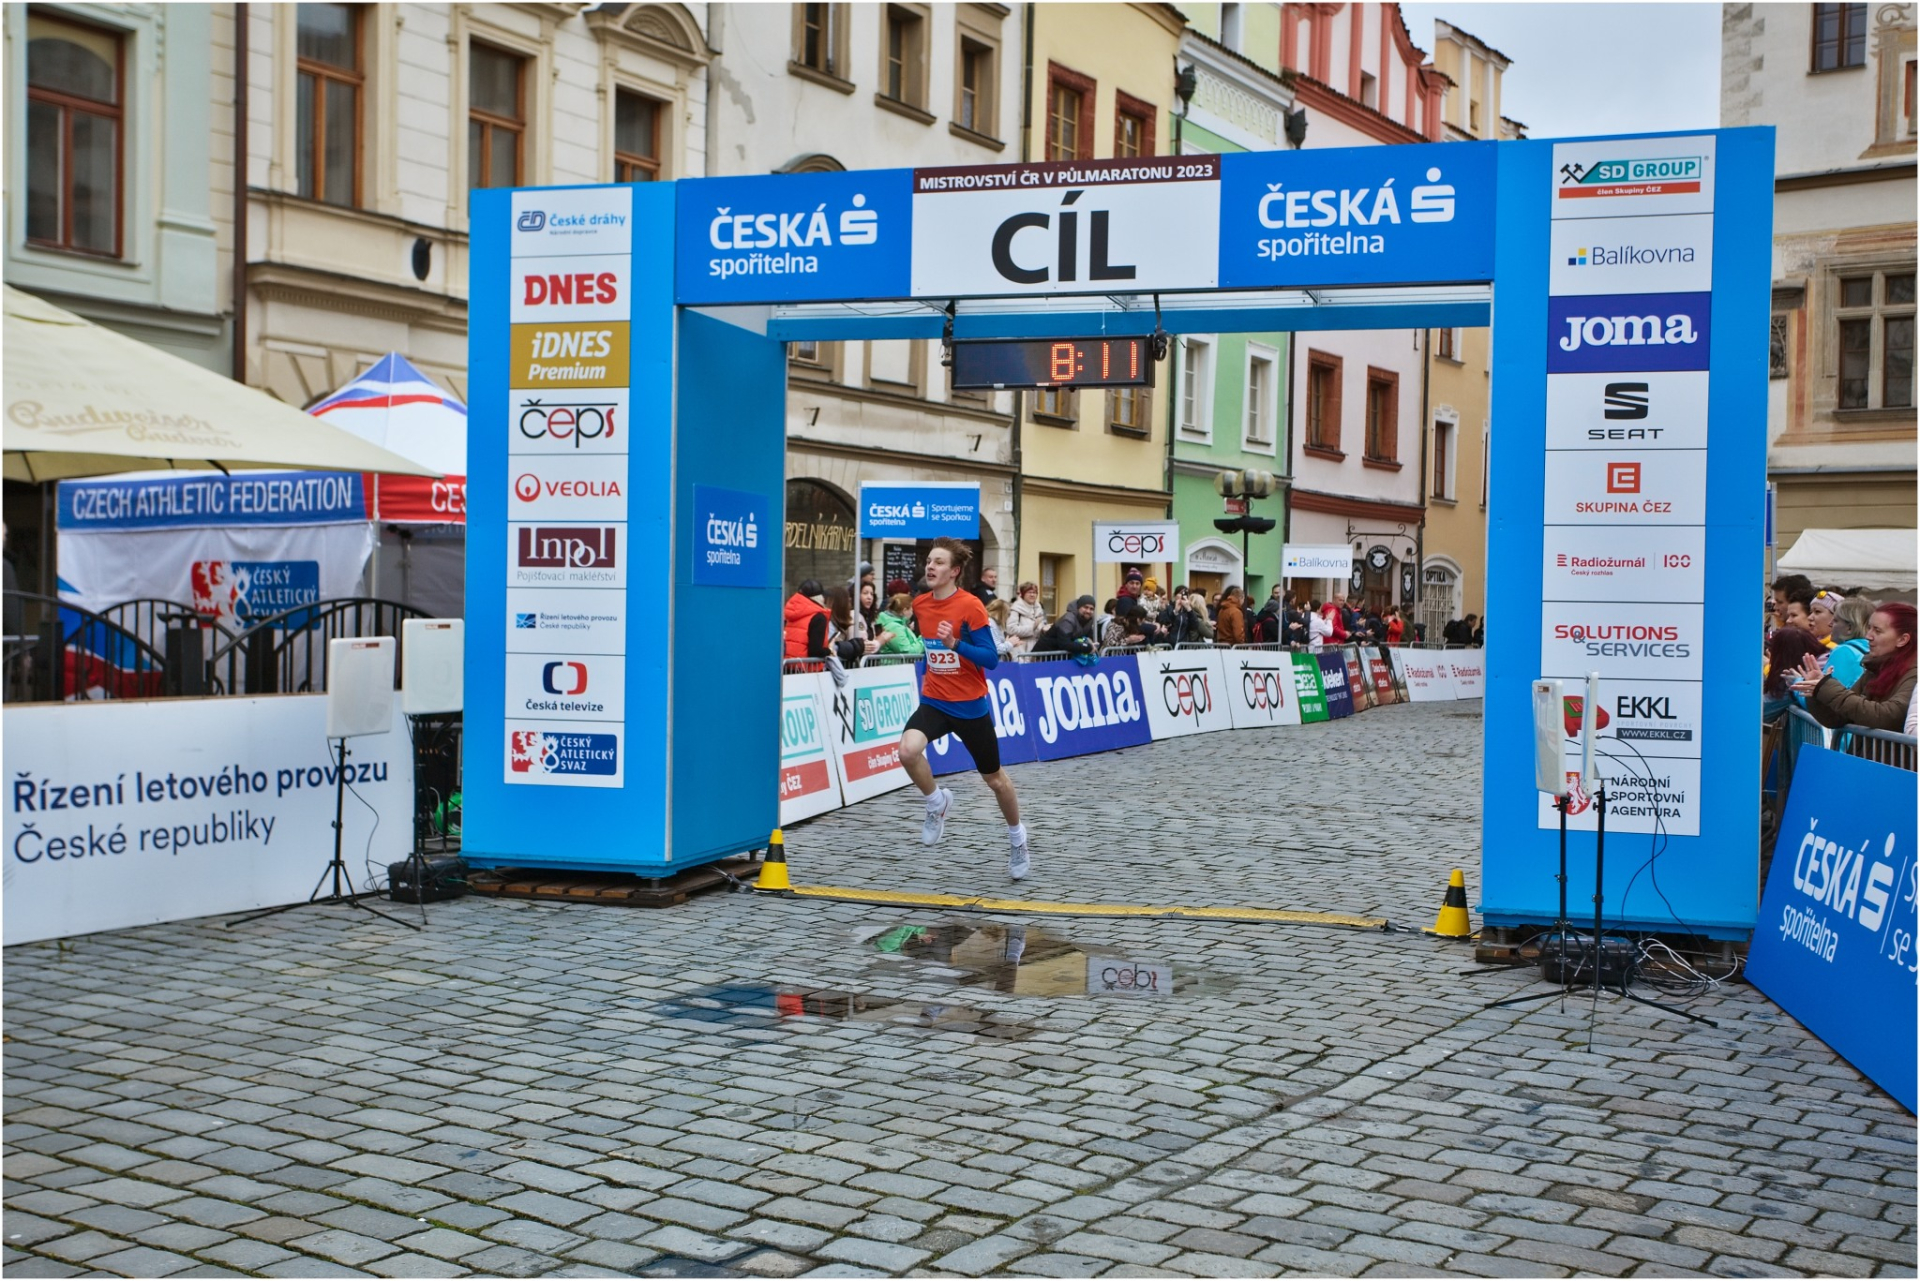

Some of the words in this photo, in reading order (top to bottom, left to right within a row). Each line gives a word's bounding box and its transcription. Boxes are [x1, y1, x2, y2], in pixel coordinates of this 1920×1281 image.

[920, 169, 1017, 191] MISTROVSTVÍ
[1020, 169, 1040, 186] ČR
[1043, 171, 1054, 185] V
[1058, 166, 1173, 184] PŮLMARATONU
[1176, 164, 1213, 179] 2023
[1598, 163, 1626, 179] SD
[1632, 160, 1697, 178] GROUP
[1597, 187, 1614, 196] člen
[1615, 186, 1645, 195] Skupiny
[1646, 185, 1662, 193] ČEZ
[1257, 178, 1402, 230] ČESKÁ
[549, 213, 585, 227] České
[589, 213, 627, 227] dráhy
[708, 203, 833, 250] ČESKÁ
[990, 189, 1138, 285] CÍL
[1256, 231, 1385, 262] spořitelna
[1591, 244, 1696, 266] Balíkovna
[708, 252, 819, 280] spořitelna
[523, 272, 618, 306] DNES
[531, 330, 613, 359] iDNES
[1051, 341, 1138, 382] 8:11
[528, 363, 607, 382] Premium
[1587, 428, 1665, 441] SEAT
[72, 488, 133, 520] CZECH
[135, 484, 226, 516] ATHLETIC
[229, 476, 353, 514] FEDERATION
[545, 480, 622, 498] VEOLIA
[869, 502, 911, 518] ČESKÁ
[931, 503, 974, 514] Sportujeme
[1575, 501, 1639, 514] SKUPINA
[1643, 499, 1672, 514] ČEZ
[706, 512, 746, 548] ČESKÁ
[868, 517, 906, 527] spořitelna
[706, 547, 741, 565] spořitelna
[1299, 556, 1349, 568] Balíkovna
[1571, 556, 1646, 569] Radiožurnál
[252, 565, 291, 586] ČESKÝ
[1571, 568, 1590, 577] Český
[251, 584, 318, 605] ATLETICKÝ
[540, 612, 561, 621] Řízení
[561, 613, 590, 621] letového
[591, 615, 618, 623] provozu
[1554, 624, 1679, 641] SOLUTIONS
[929, 652, 956, 664] 923
[1585, 642, 1691, 658] SERVICES
[525, 698, 558, 711] Česká
[560, 700, 604, 713] televize
[858, 697, 875, 733] SD
[876, 691, 913, 729] GROUP
[1617, 696, 1678, 720] EKKL
[560, 735, 593, 749] ČESKÝ
[1621, 729, 1687, 740] WWW.EKKL.CZ
[560, 748, 615, 761] ATLETICKÝ
[560, 760, 587, 772] SVAZ
[13, 771, 125, 813] Řízení
[136, 764, 269, 804] letového
[276, 761, 388, 798] provozu
[1610, 773, 1671, 789] NÁRODNÍ
[1609, 790, 1685, 804] SPORTOVNÍ
[1609, 805, 1682, 818] AGENTURA
[13, 822, 128, 864] České
[140, 809, 276, 856] republiky
[1792, 816, 1869, 920] ČESKÁ
[1779, 903, 1839, 964] spořitelna
[1888, 928, 1912, 967] se
